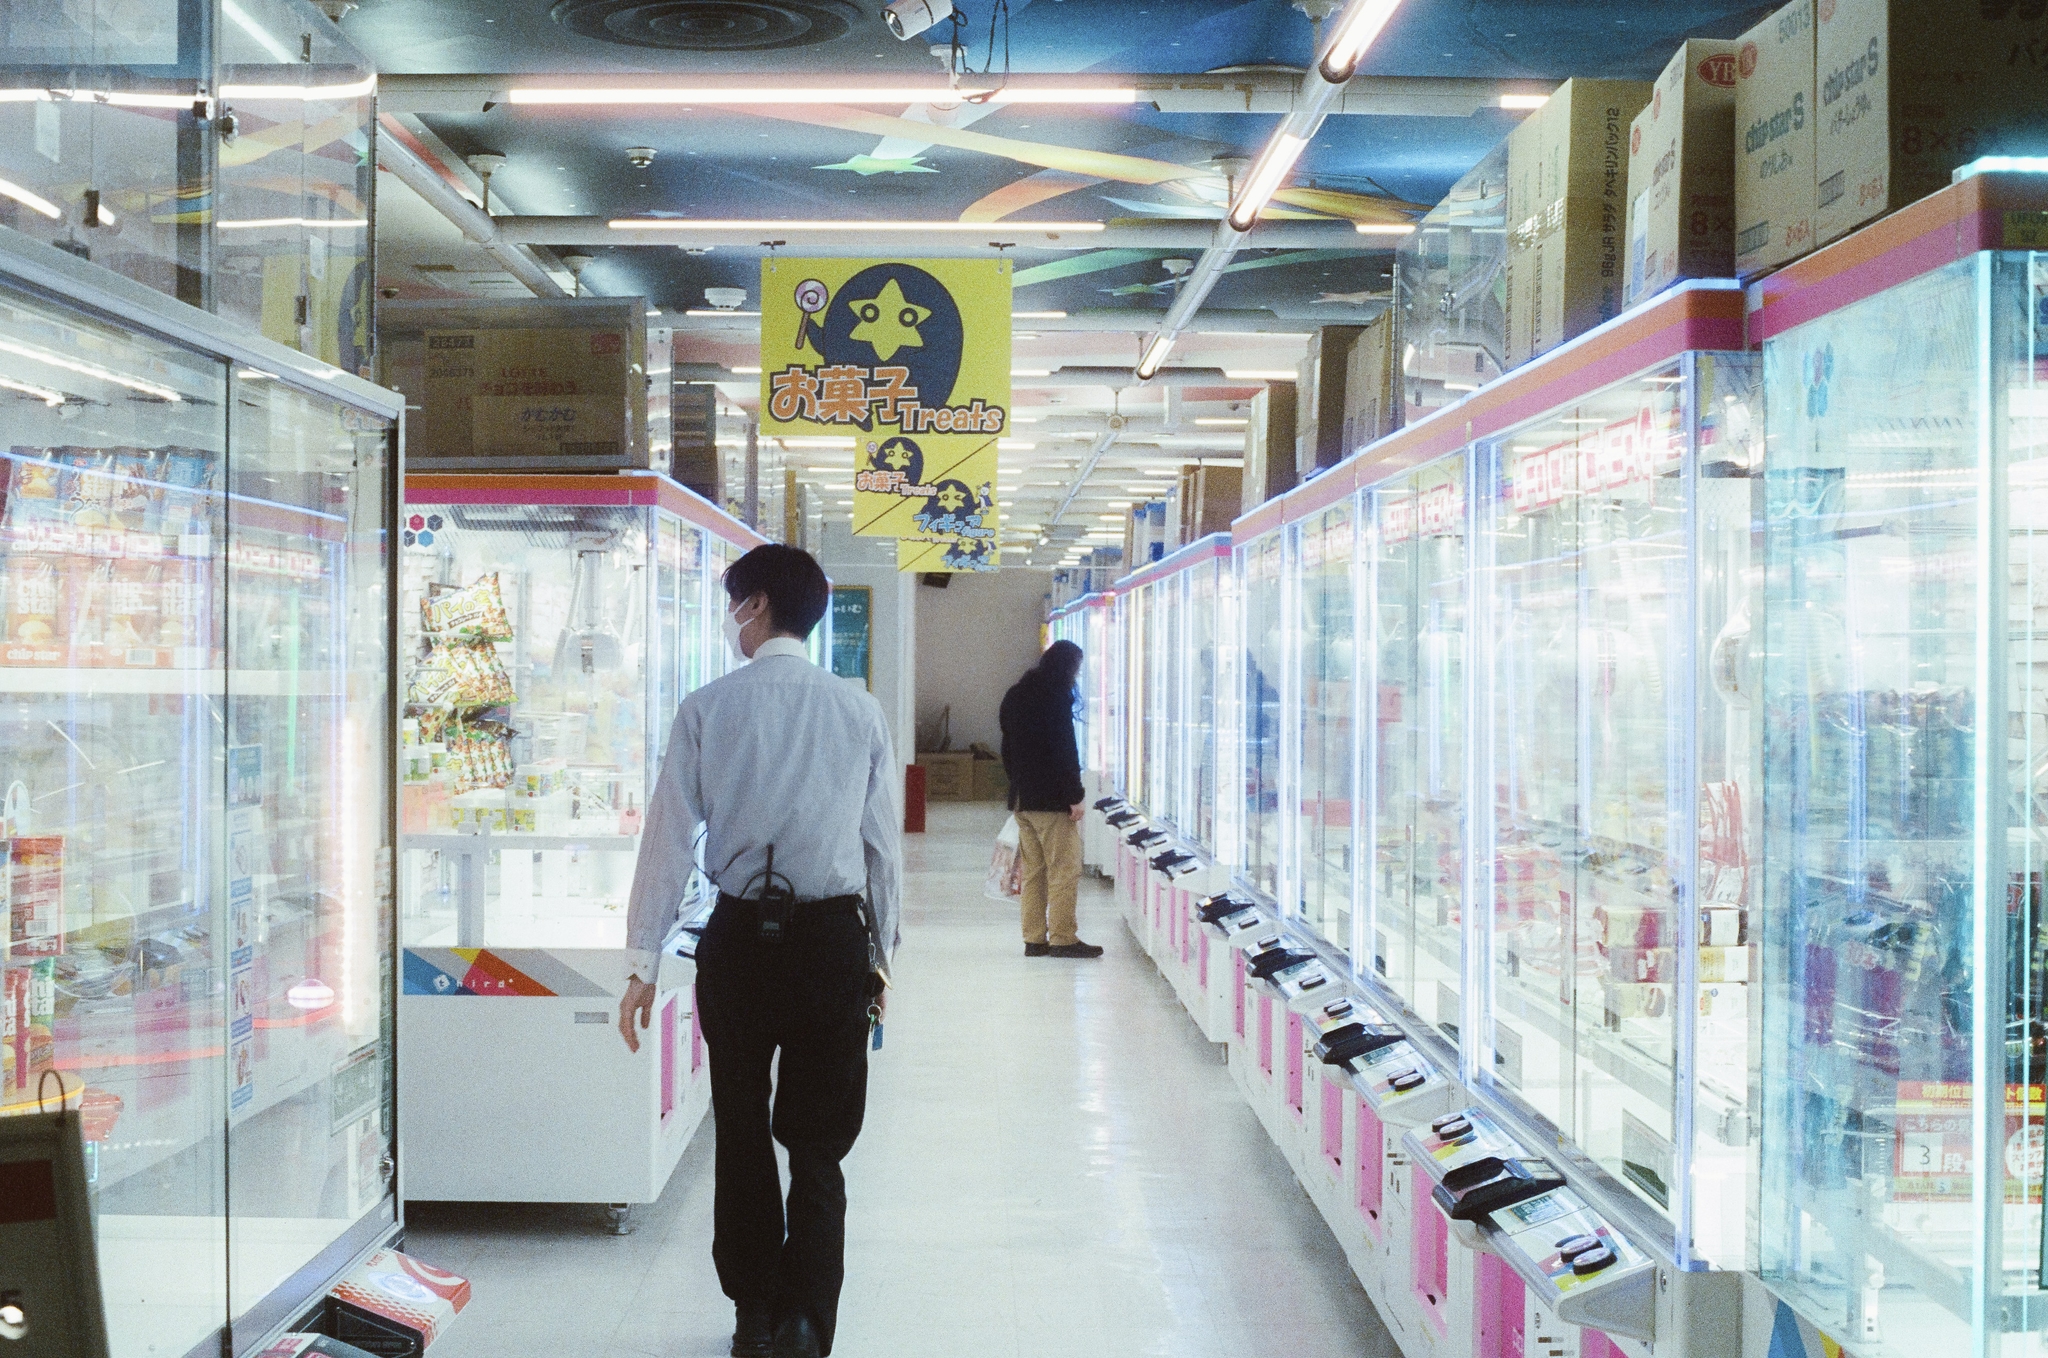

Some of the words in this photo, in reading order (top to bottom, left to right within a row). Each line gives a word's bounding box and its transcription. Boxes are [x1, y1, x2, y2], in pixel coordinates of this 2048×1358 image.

[769, 365, 918, 424] お菓子
[899, 401, 1004, 433] Treats
[857, 470, 909, 493] お菓子
[914, 512, 982, 533] フィギュア
[433, 975, 505, 992] third
[1919, 1144, 1931, 1166] 3
